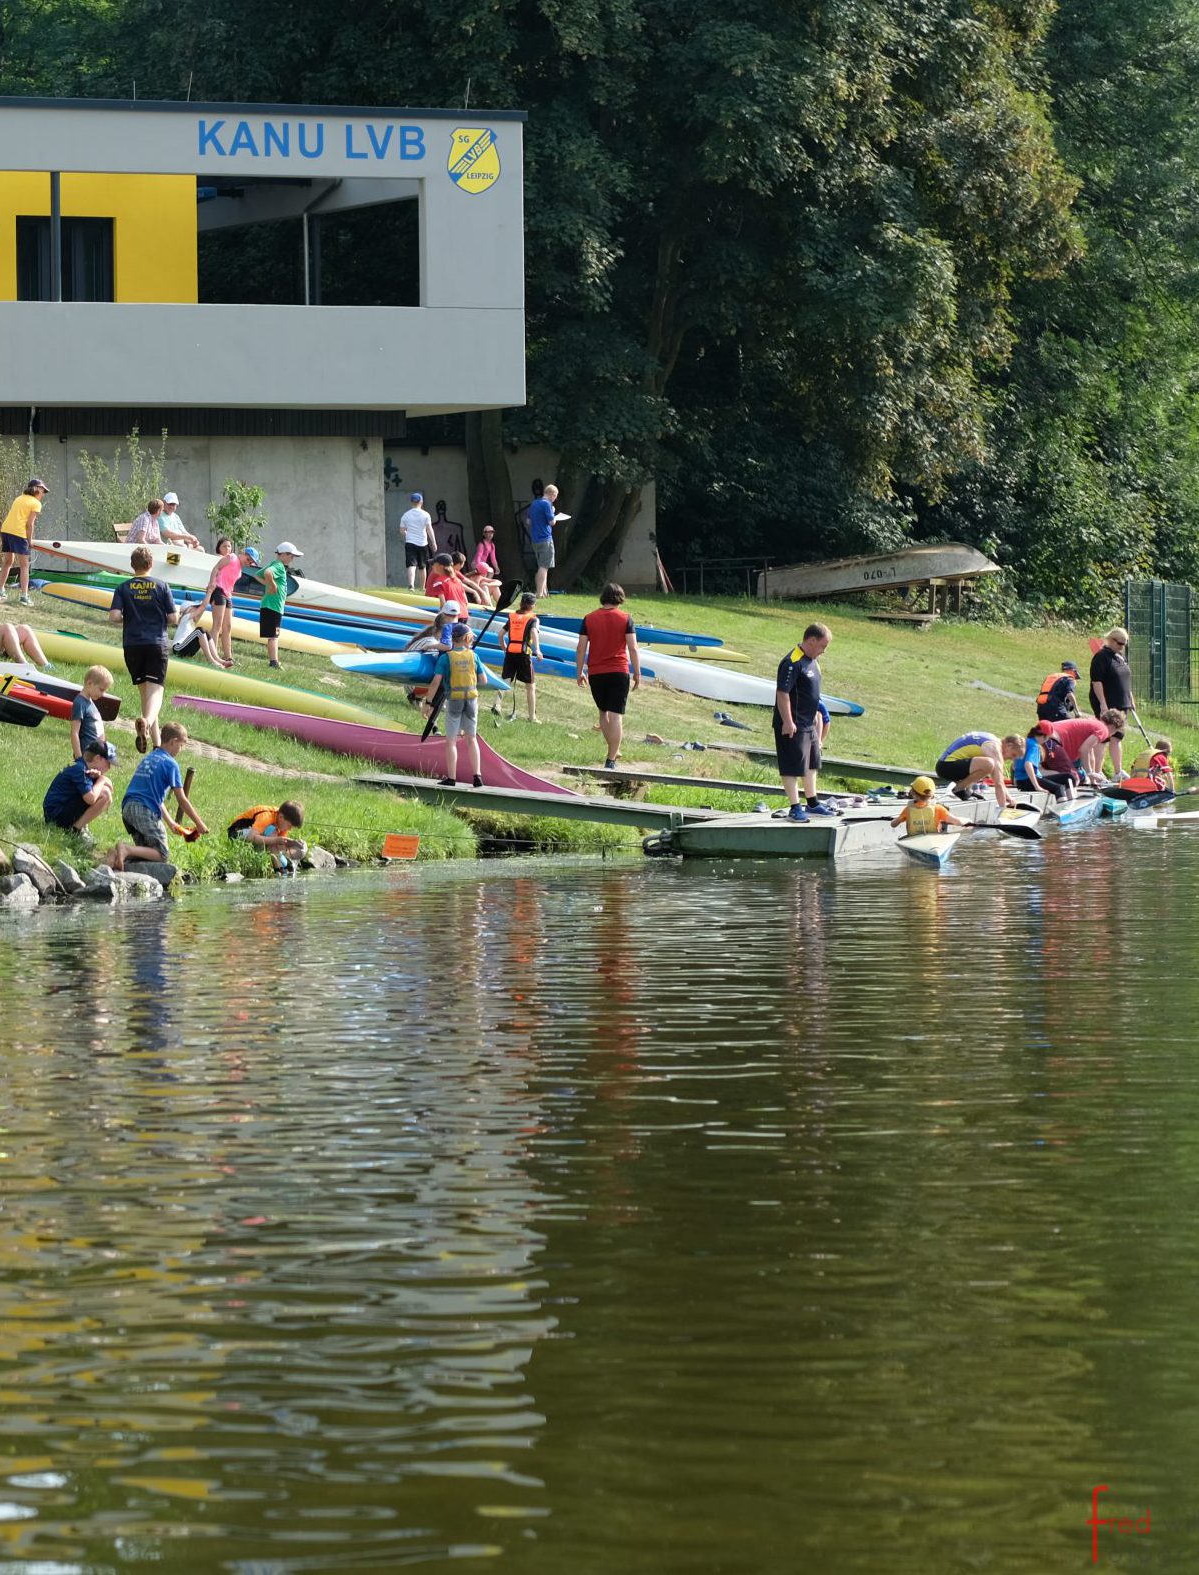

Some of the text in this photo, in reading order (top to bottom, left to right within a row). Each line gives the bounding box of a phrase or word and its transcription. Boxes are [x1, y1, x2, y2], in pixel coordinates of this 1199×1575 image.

[198, 120, 426, 161] KANU LVB
[458, 135, 470, 143] SG
[463, 144, 483, 165] LVB
[466, 172, 494, 180] LEIPZIG
[130, 581, 157, 590] KANU
[1, 675, 15, 696] 1
